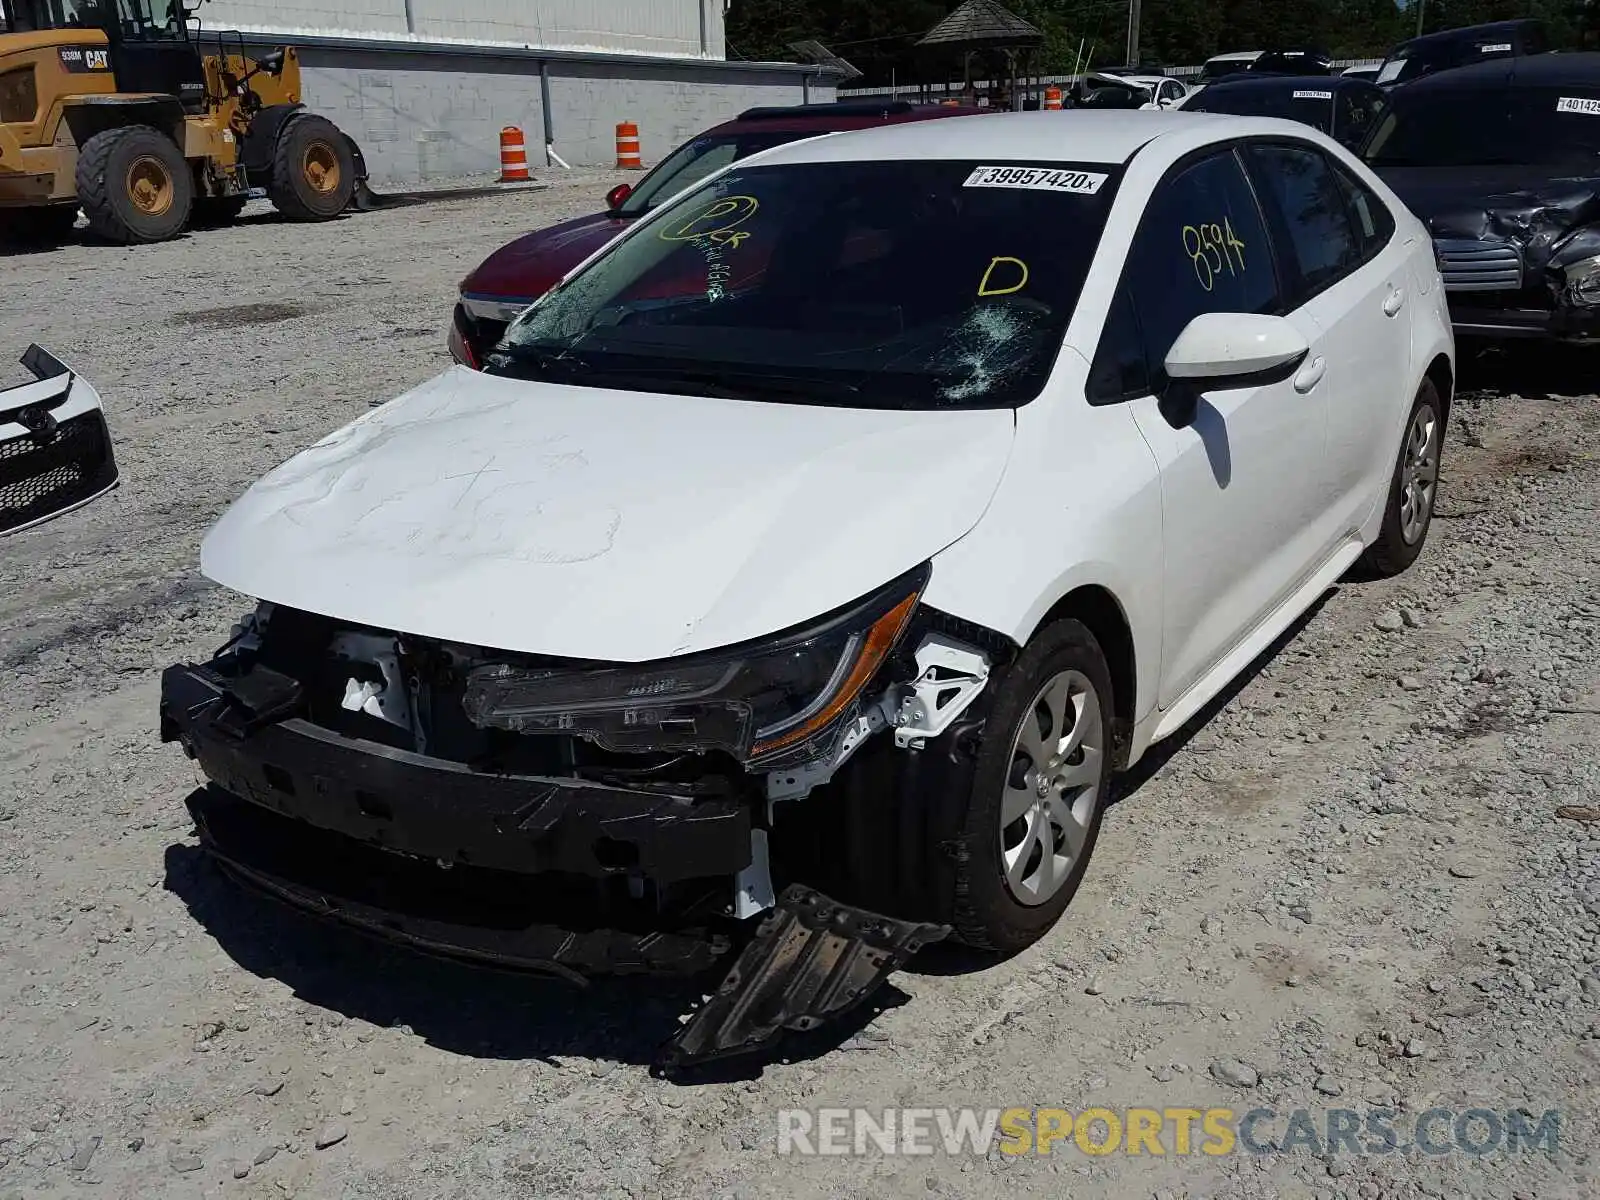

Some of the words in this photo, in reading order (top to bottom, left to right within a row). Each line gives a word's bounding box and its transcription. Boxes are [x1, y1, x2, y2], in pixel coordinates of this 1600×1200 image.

[61, 50, 82, 61] 938M
[85, 50, 108, 69] CAT
[1183, 215, 1245, 291] 8594
[978, 256, 1028, 296] D
